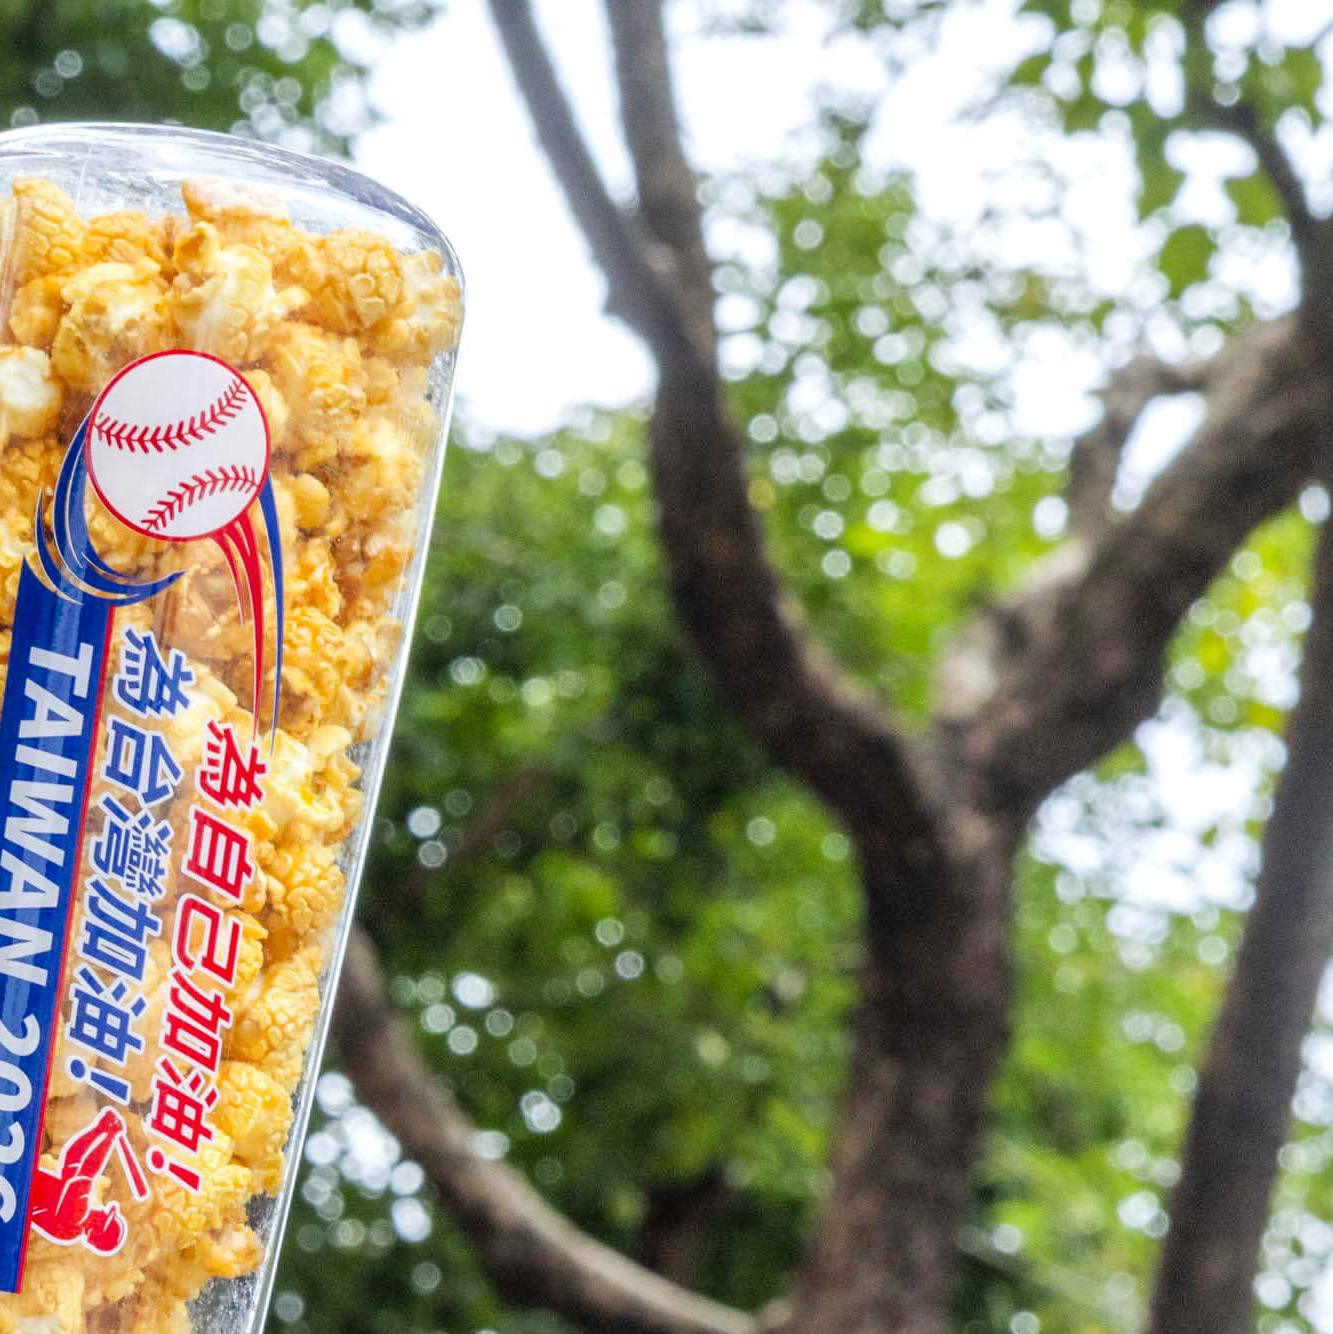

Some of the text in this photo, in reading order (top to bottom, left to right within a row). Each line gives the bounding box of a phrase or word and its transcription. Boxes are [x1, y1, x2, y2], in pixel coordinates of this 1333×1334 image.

[67, 629, 192, 1103] 為台灣加油!
[150, 720, 267, 1192] 為自己加油!
